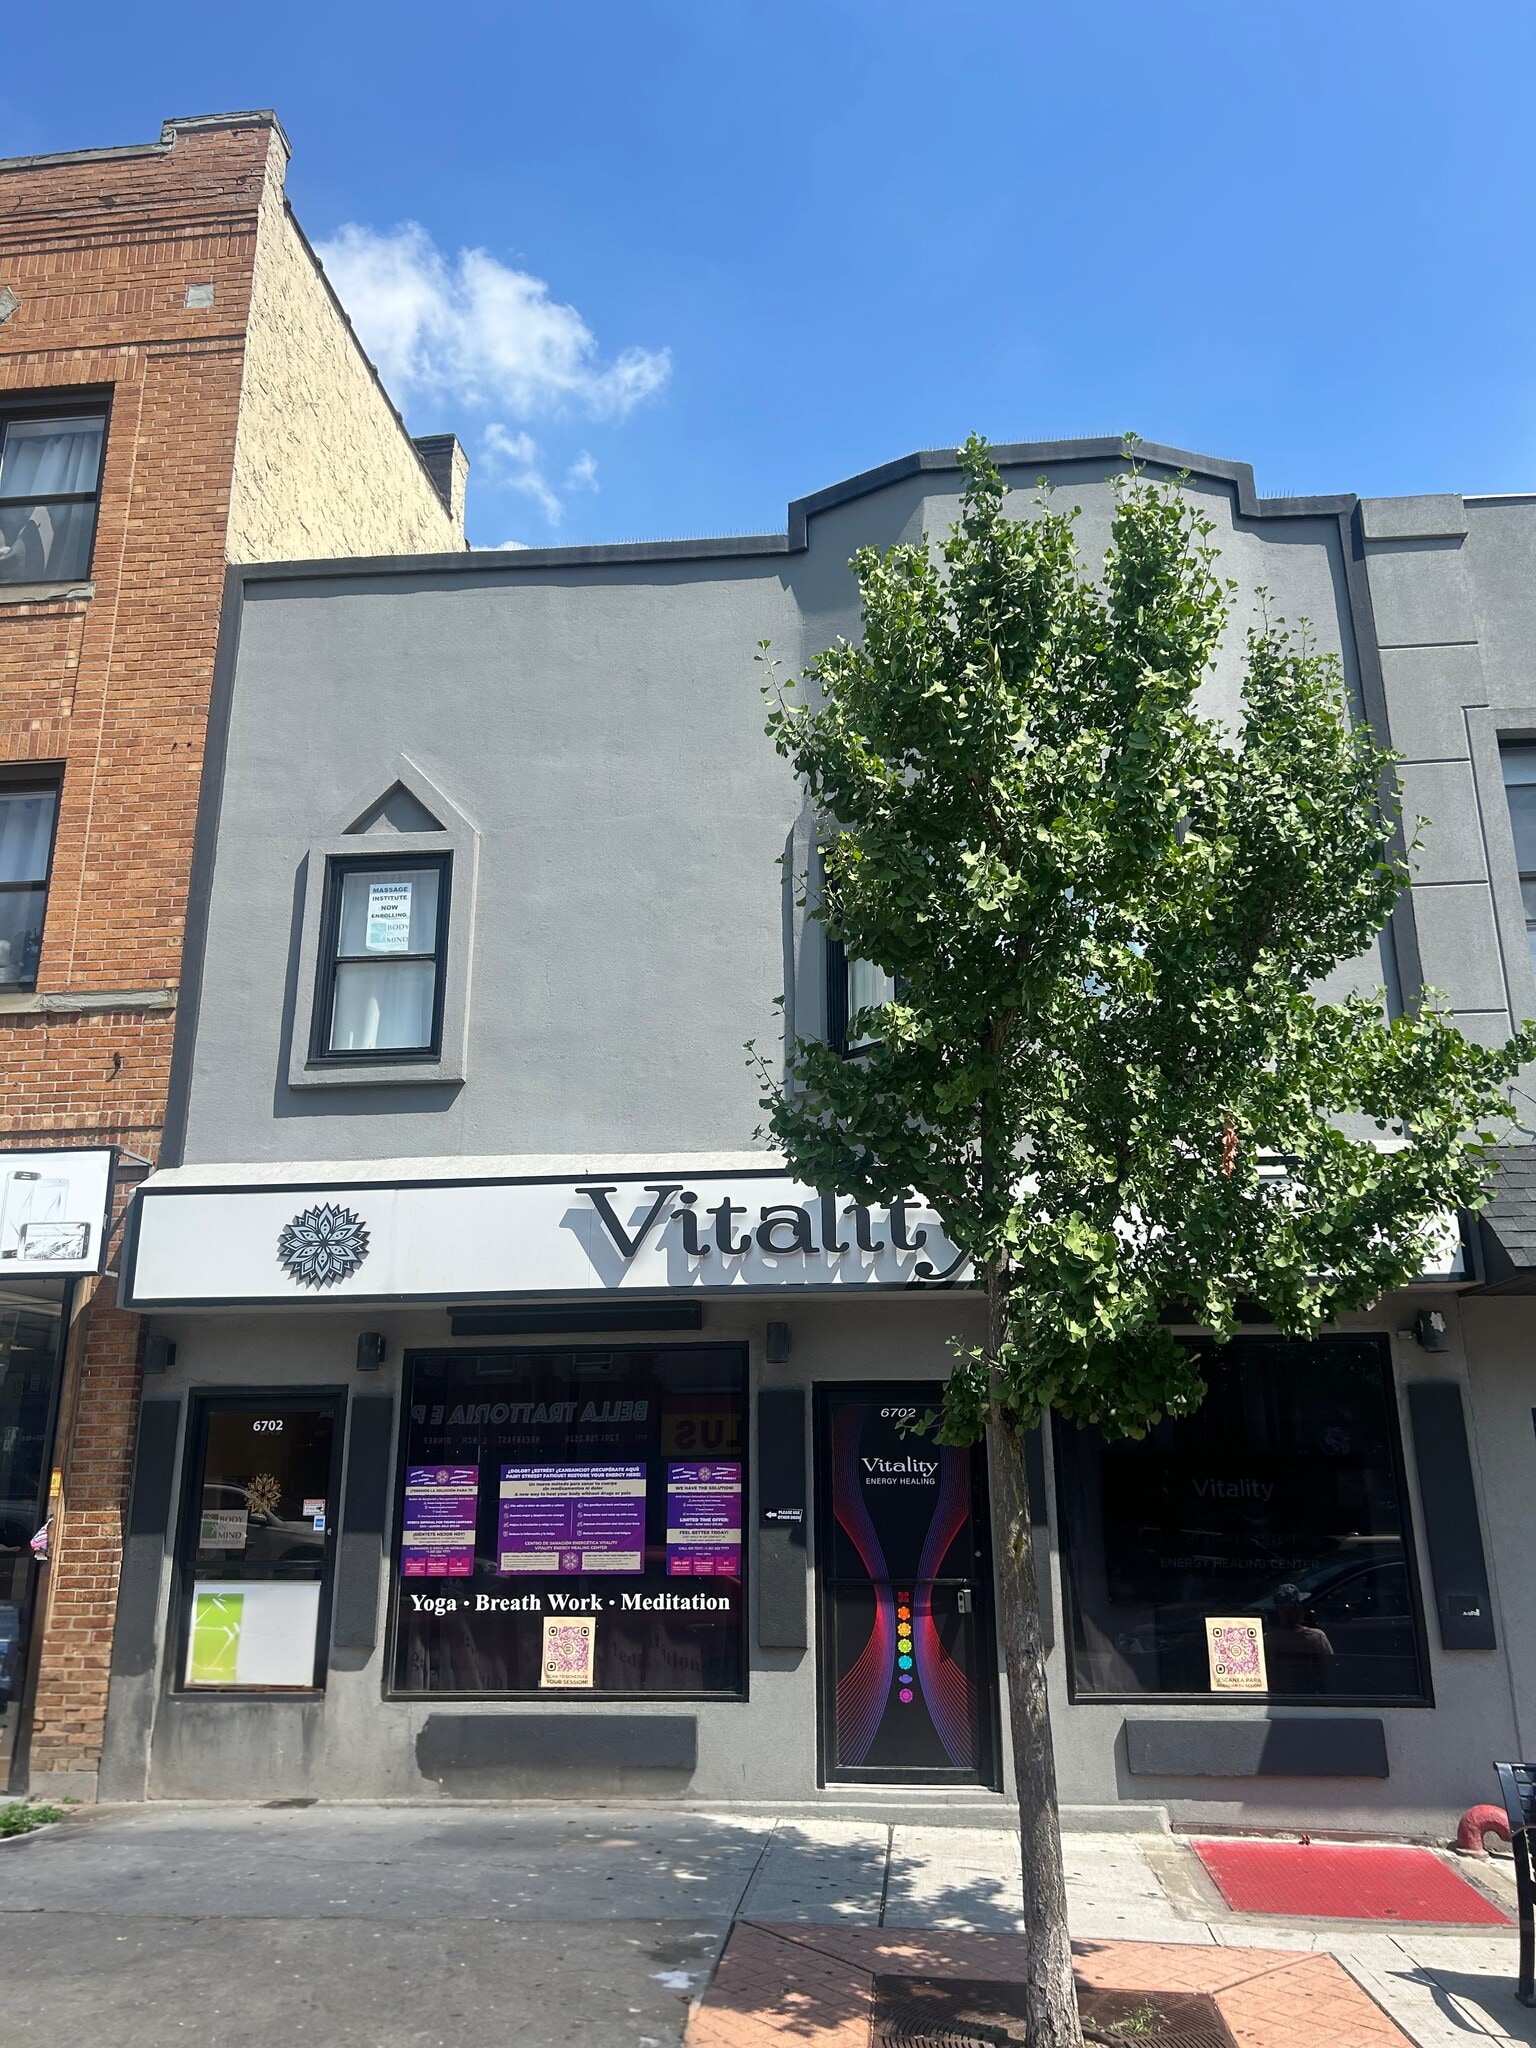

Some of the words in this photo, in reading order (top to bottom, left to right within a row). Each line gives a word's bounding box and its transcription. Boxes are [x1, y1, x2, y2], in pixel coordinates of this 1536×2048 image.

[880, 1408, 916, 1418] 6702
[253, 1420, 283, 1431] 6702
[861, 1456, 939, 1478] Vitality
[1192, 1478, 1275, 1502] Vitality
[218, 1531, 242, 1539] MIND
[1160, 1557, 1209, 1569] ENERGY
[1213, 1557, 1266, 1569] HEALING
[1270, 1557, 1321, 1569] CENTER
[410, 1594, 458, 1616] Yoga
[475, 1594, 542, 1611] Breath
[547, 1593, 603, 1610] Work
[621, 1593, 730, 1610] Meditation
